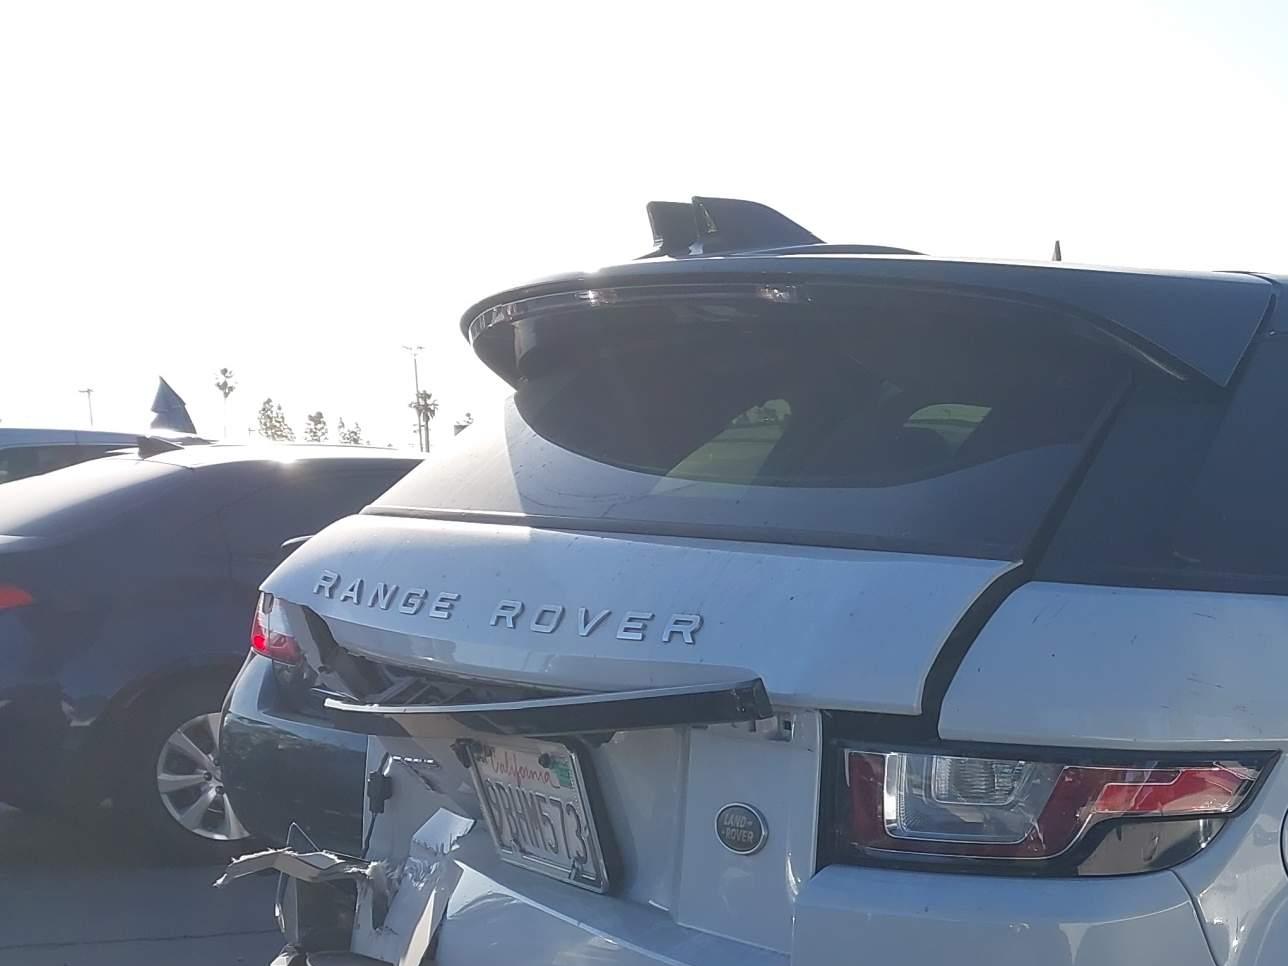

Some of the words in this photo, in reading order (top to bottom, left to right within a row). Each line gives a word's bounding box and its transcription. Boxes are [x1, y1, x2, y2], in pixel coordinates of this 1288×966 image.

[312, 569, 461, 619] RANGE
[489, 600, 704, 645] ROVER
[491, 748, 562, 788] California
[485, 778, 588, 865] 9BHM573
